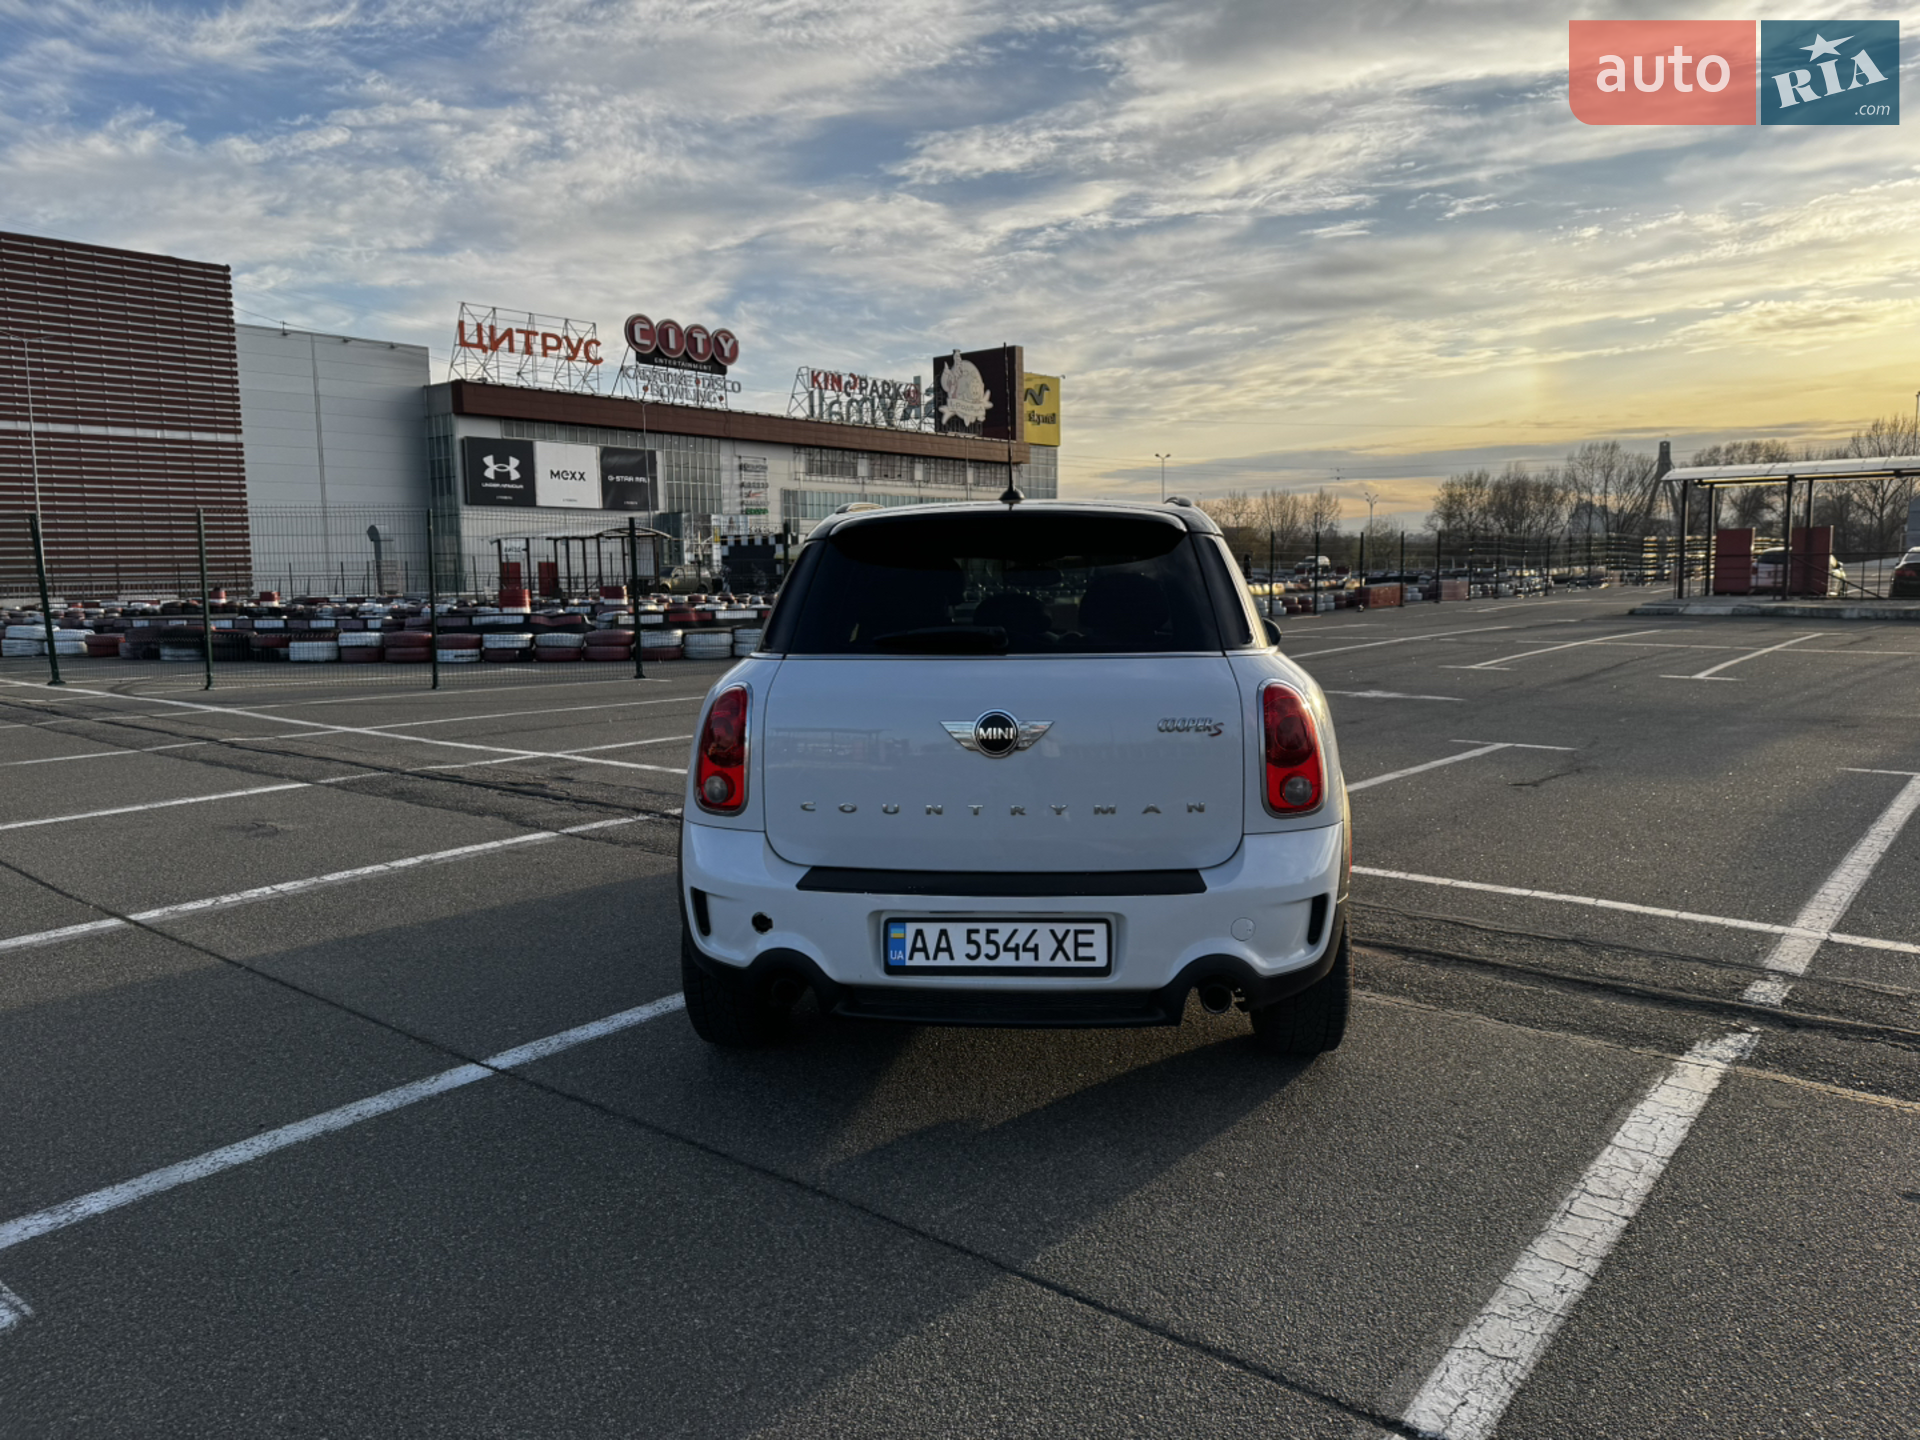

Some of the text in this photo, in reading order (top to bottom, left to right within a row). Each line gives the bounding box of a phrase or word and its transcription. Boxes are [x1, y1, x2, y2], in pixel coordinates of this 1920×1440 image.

[458, 319, 604, 365] ЦИТРУС
[633, 322, 737, 358] CITY
[654, 357, 713, 371] ENTERTAINMENT
[701, 375, 742, 394] DISCO
[978, 726, 1015, 740] MINI
[1157, 717, 1213, 733] COOPER
[800, 801, 1206, 816] COUNTRYMAN
[890, 928, 1096, 962] UA AA 5544 XE
